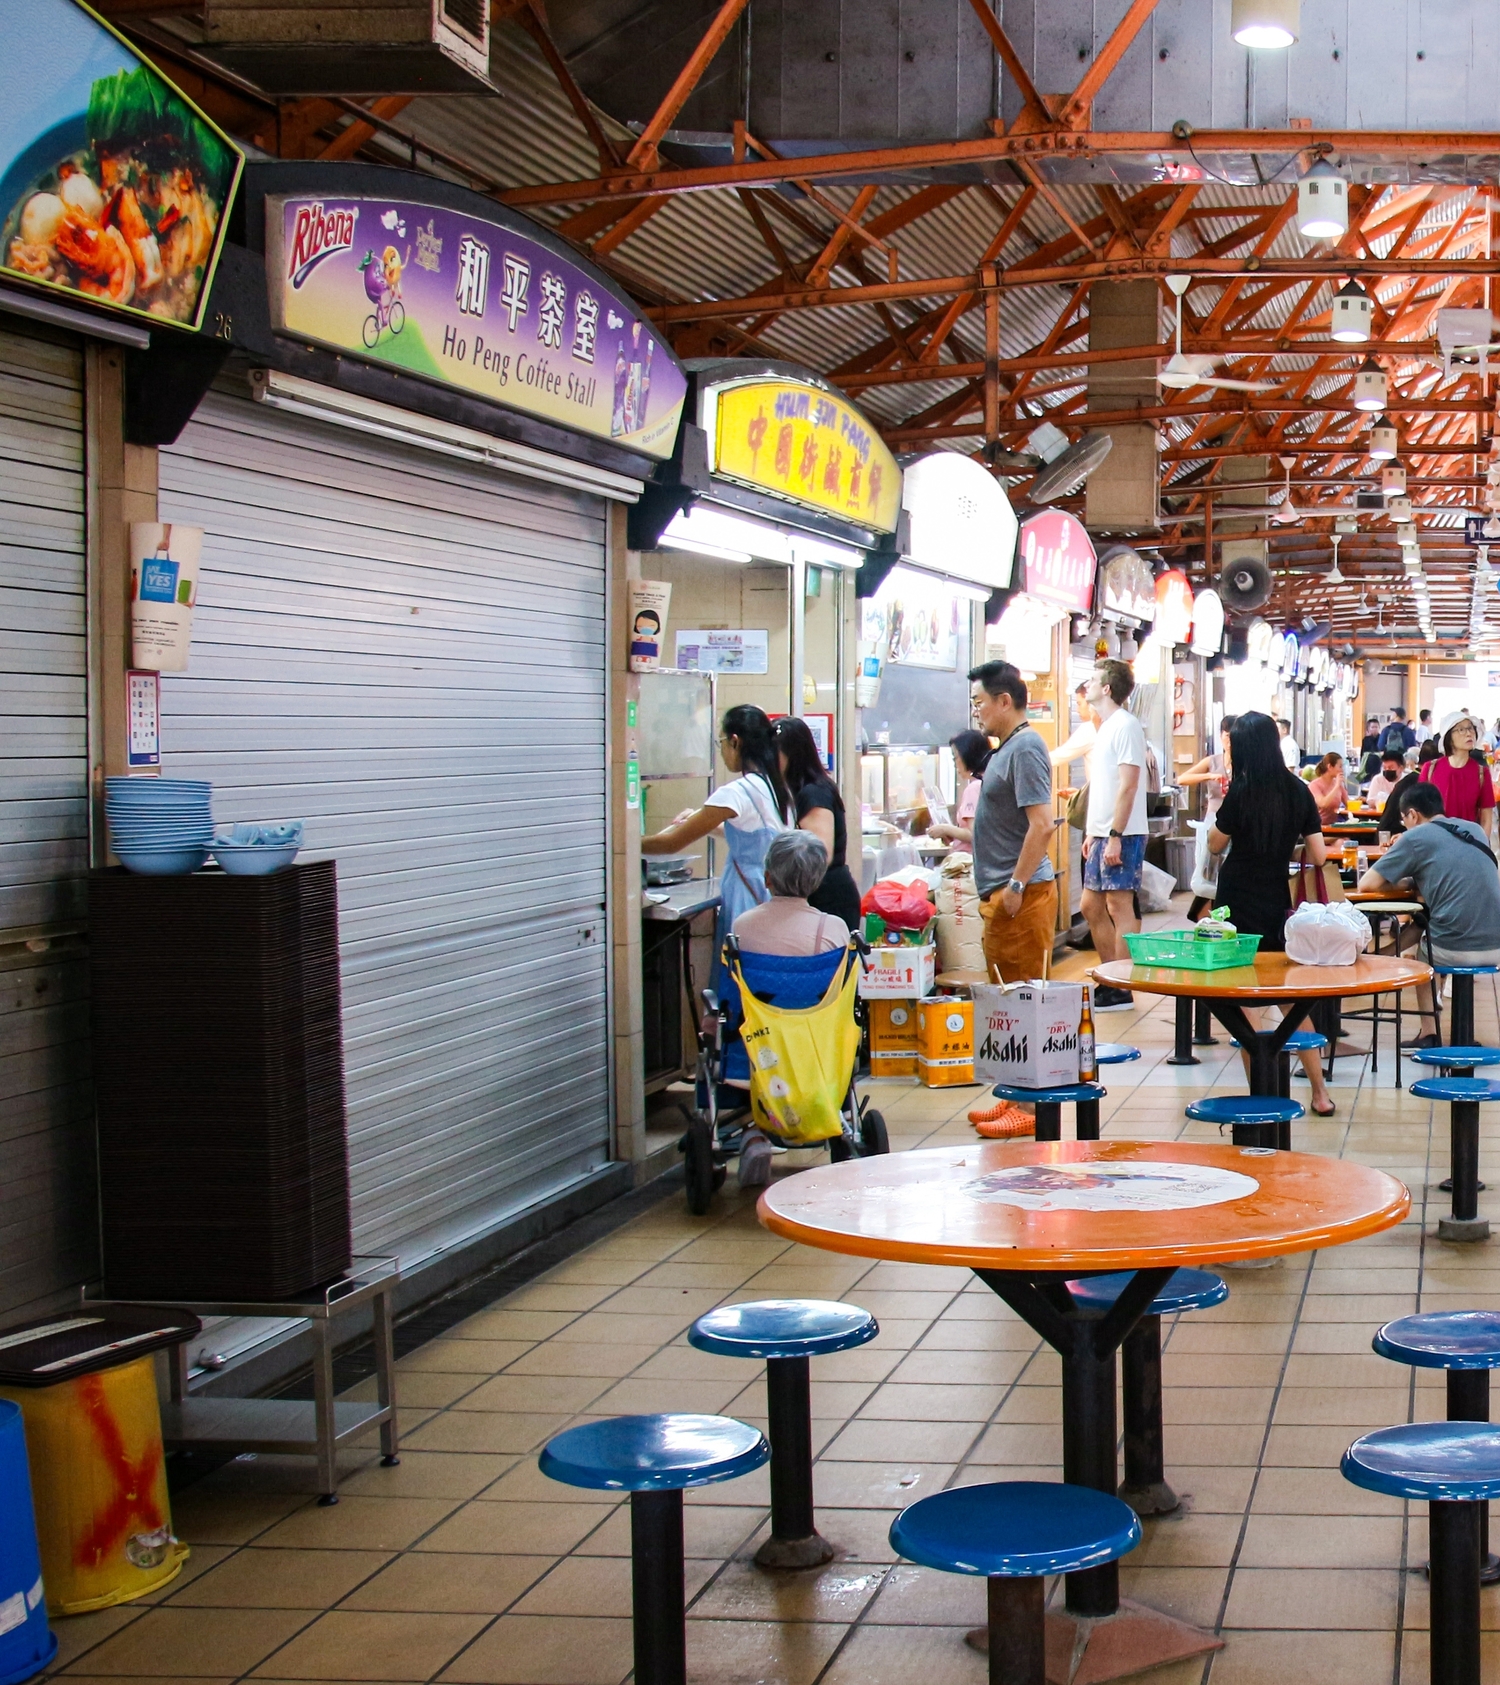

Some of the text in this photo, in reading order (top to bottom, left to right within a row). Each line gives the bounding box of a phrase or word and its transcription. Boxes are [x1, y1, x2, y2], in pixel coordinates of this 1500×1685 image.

[288, 204, 355, 280] Ribena
[457, 236, 599, 364] 和平茶室
[215, 311, 232, 341] 26
[442, 324, 467, 362] Ho
[472, 335, 511, 387] Peng
[515, 353, 562, 396] Coffee
[565, 372, 597, 408] Stall
[147, 573, 172, 587] YES
[954, 905, 963, 926] IKAN
[979, 1032, 1029, 1064] Asahi
[1042, 1033, 1077, 1054] Asahi
